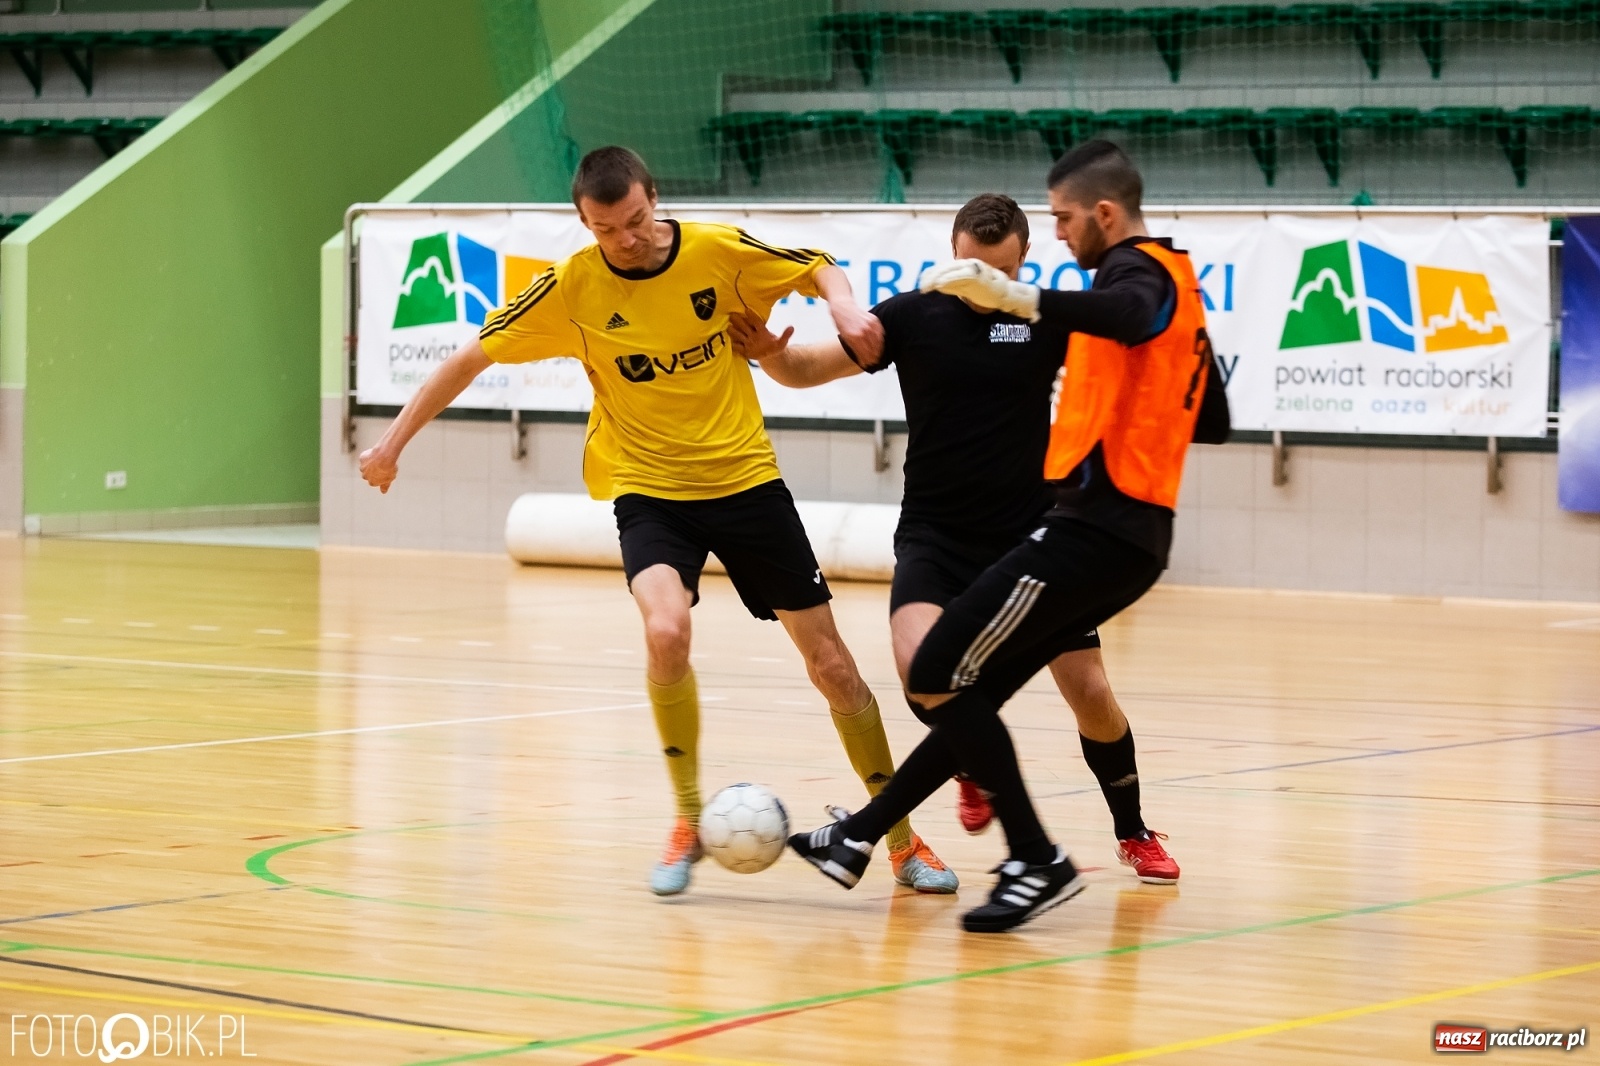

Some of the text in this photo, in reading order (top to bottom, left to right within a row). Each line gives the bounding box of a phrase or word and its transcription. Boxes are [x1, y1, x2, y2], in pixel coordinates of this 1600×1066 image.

[473, 373, 509, 388] aza
[1276, 359, 1512, 391] powiat raciborski
[1276, 395, 1511, 416] zielona oaza kultur
